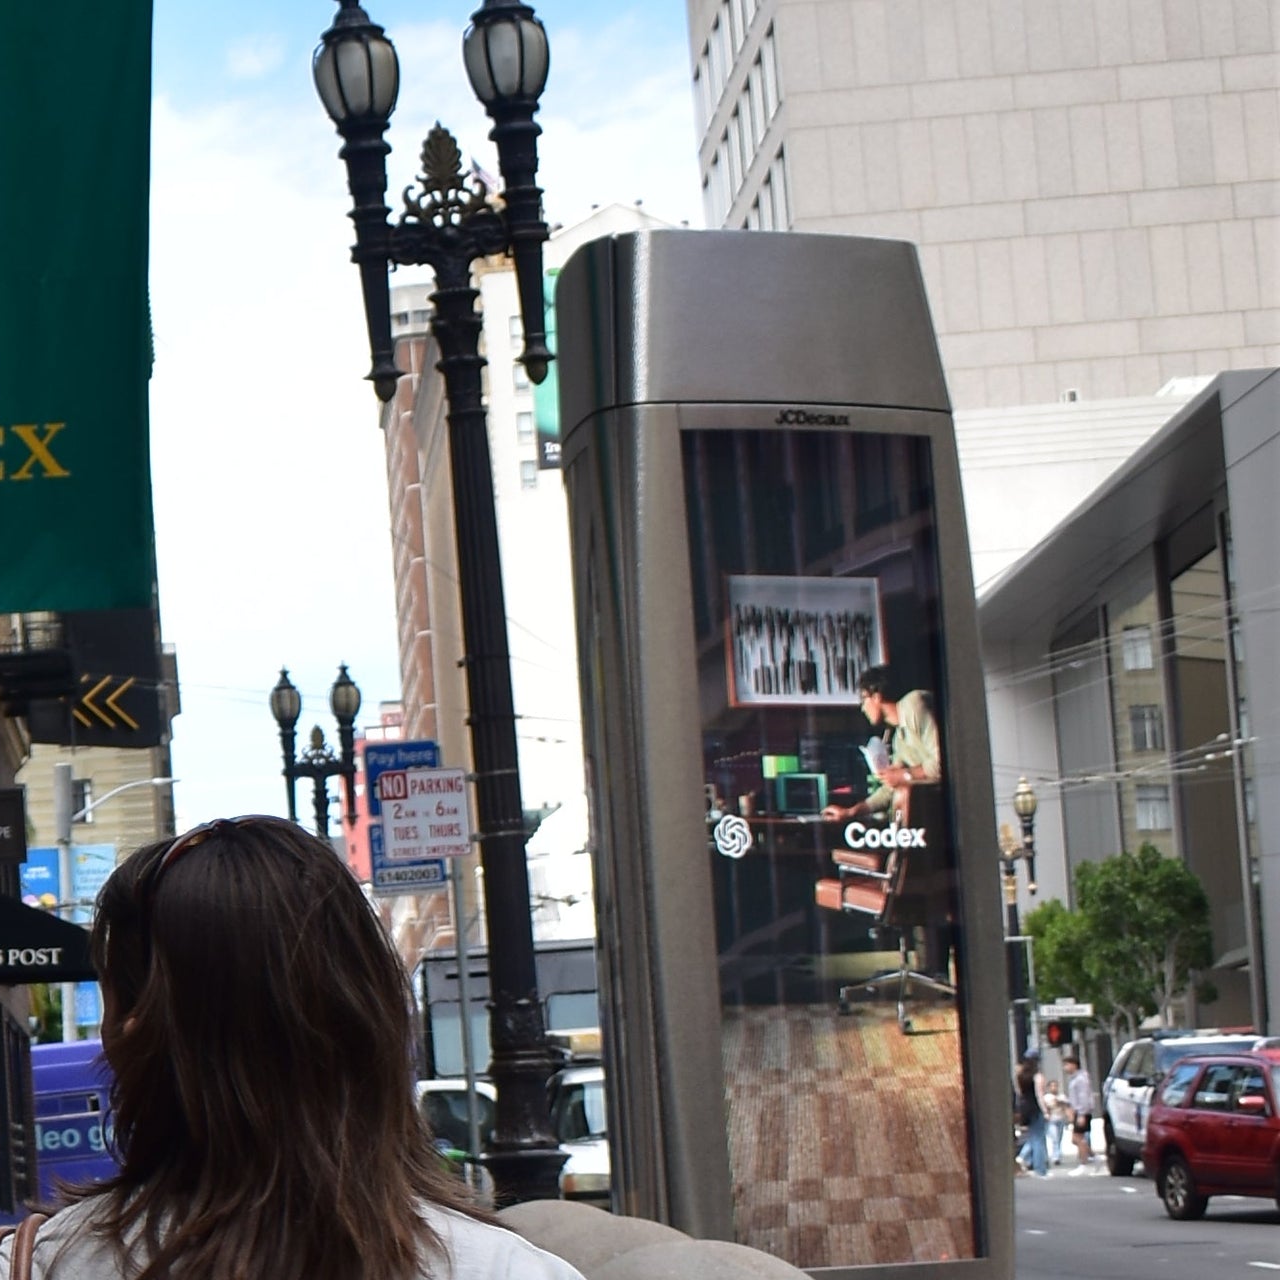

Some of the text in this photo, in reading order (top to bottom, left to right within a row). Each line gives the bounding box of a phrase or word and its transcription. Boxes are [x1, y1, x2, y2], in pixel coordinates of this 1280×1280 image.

[381, 774, 464, 798] NO PARKING
[844, 821, 927, 848] Codex
[7, 947, 62, 966] POST
